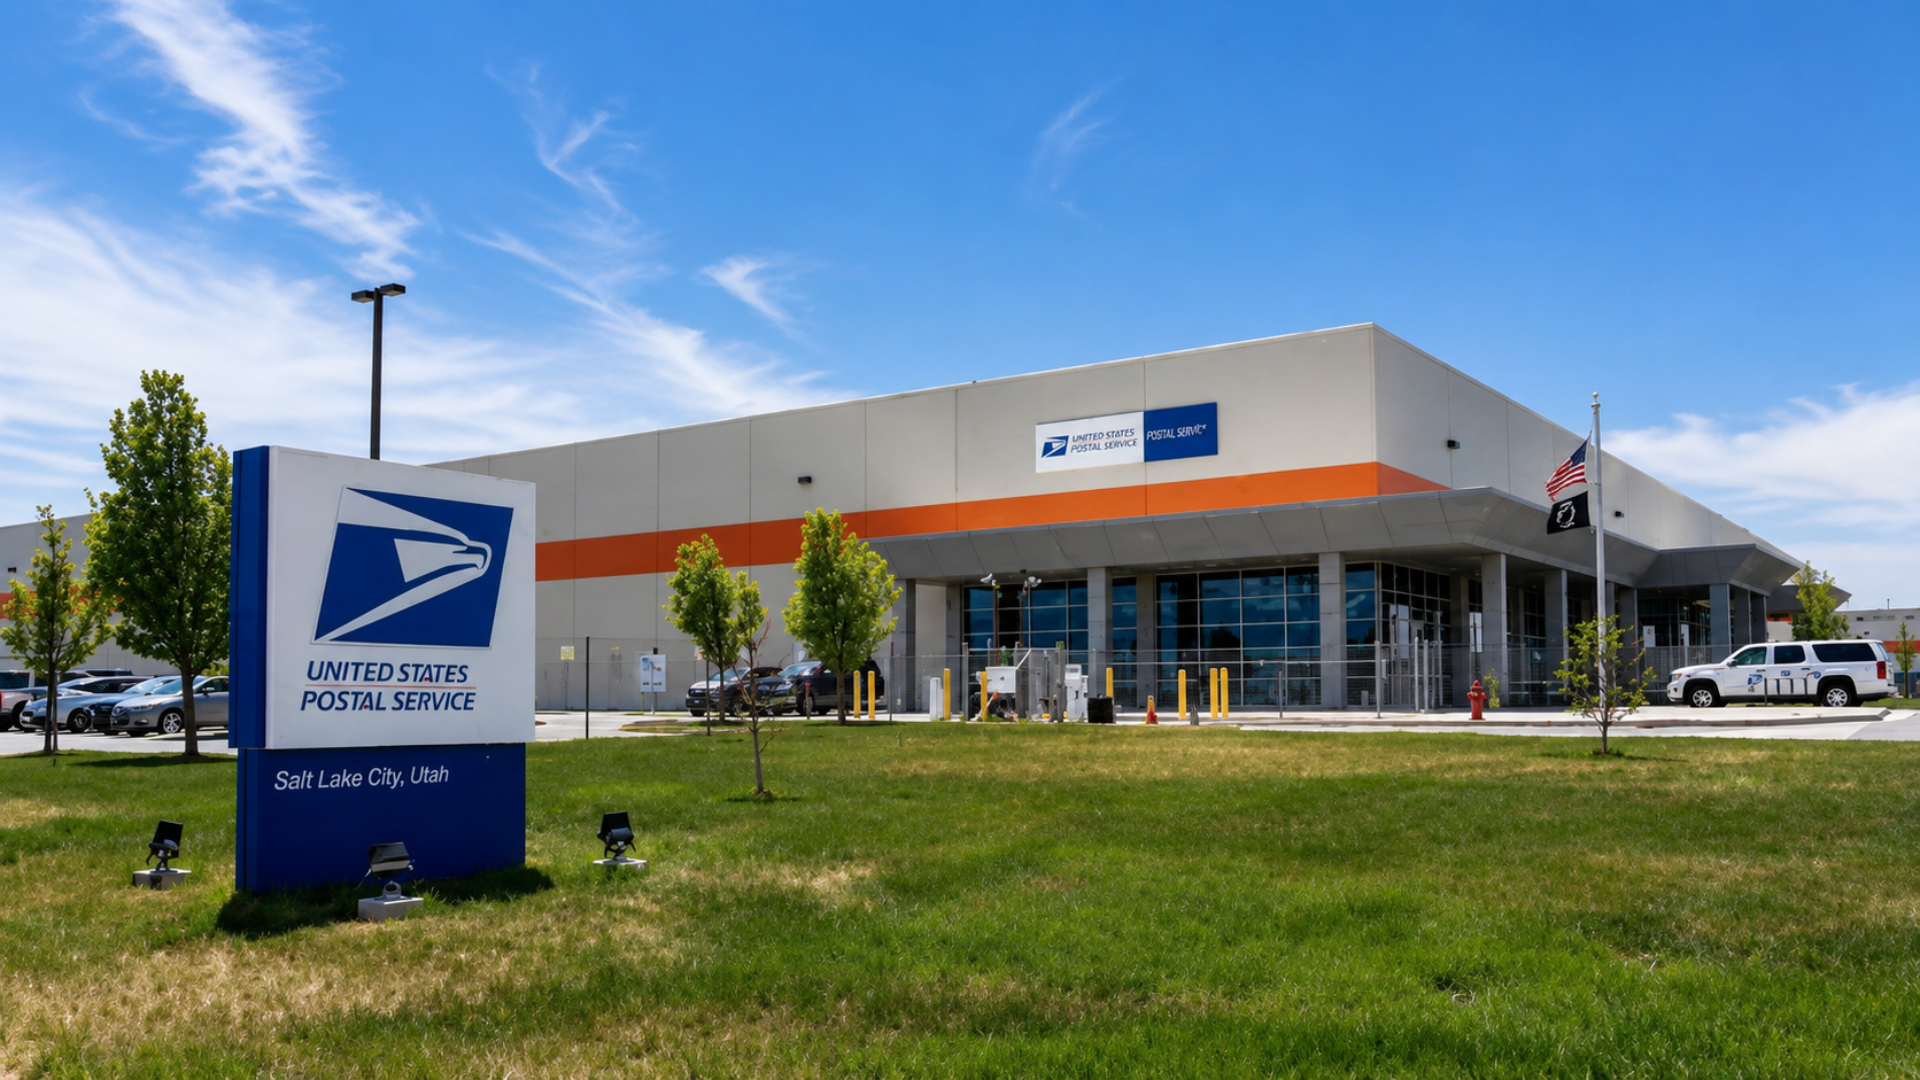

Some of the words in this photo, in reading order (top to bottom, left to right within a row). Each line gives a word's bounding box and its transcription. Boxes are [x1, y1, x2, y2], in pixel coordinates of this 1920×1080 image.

[1072, 431, 1105, 443] UNITED
[1105, 428, 1135, 439] STATES
[1146, 428, 1176, 441] POSTAL
[1070, 442, 1102, 453] POSTAL
[1104, 437, 1138, 451] SERVICE
[306, 660, 395, 682] UNITED
[396, 663, 469, 683] STATES
[300, 690, 387, 711] POSTAL
[391, 691, 477, 711] SERVICE
[274, 770, 314, 791] Salt
[317, 768, 363, 789] Lake
[367, 766, 405, 790] City,
[409, 765, 450, 784] Utah
